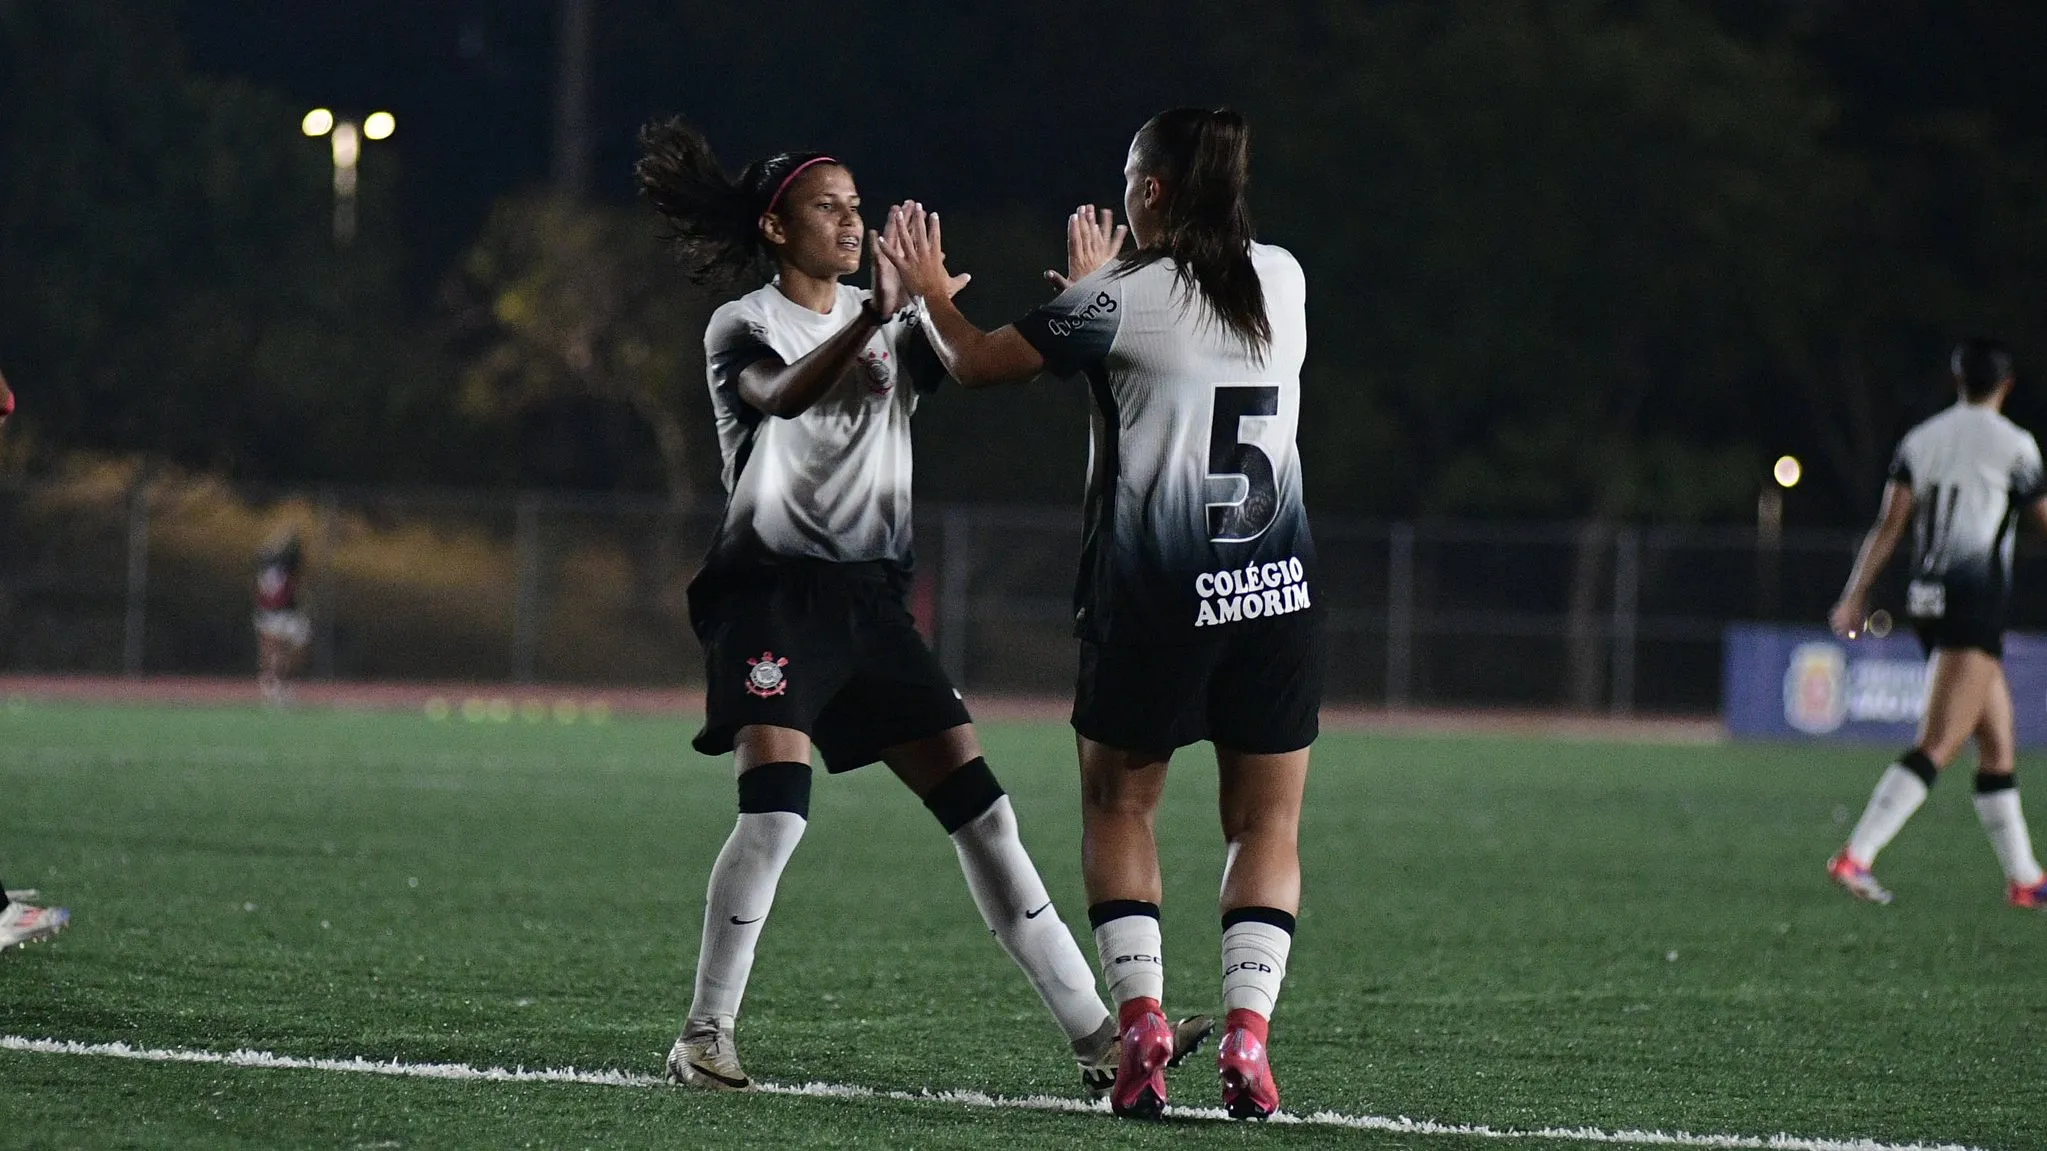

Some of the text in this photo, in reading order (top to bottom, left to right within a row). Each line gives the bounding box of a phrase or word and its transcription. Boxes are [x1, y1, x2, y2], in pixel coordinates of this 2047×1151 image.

[1205, 382, 1280, 543] 5
[1195, 556, 1304, 598] COLÉGIO
[1194, 581, 1311, 627] AMORIM
[1223, 961, 1271, 979] CCP
